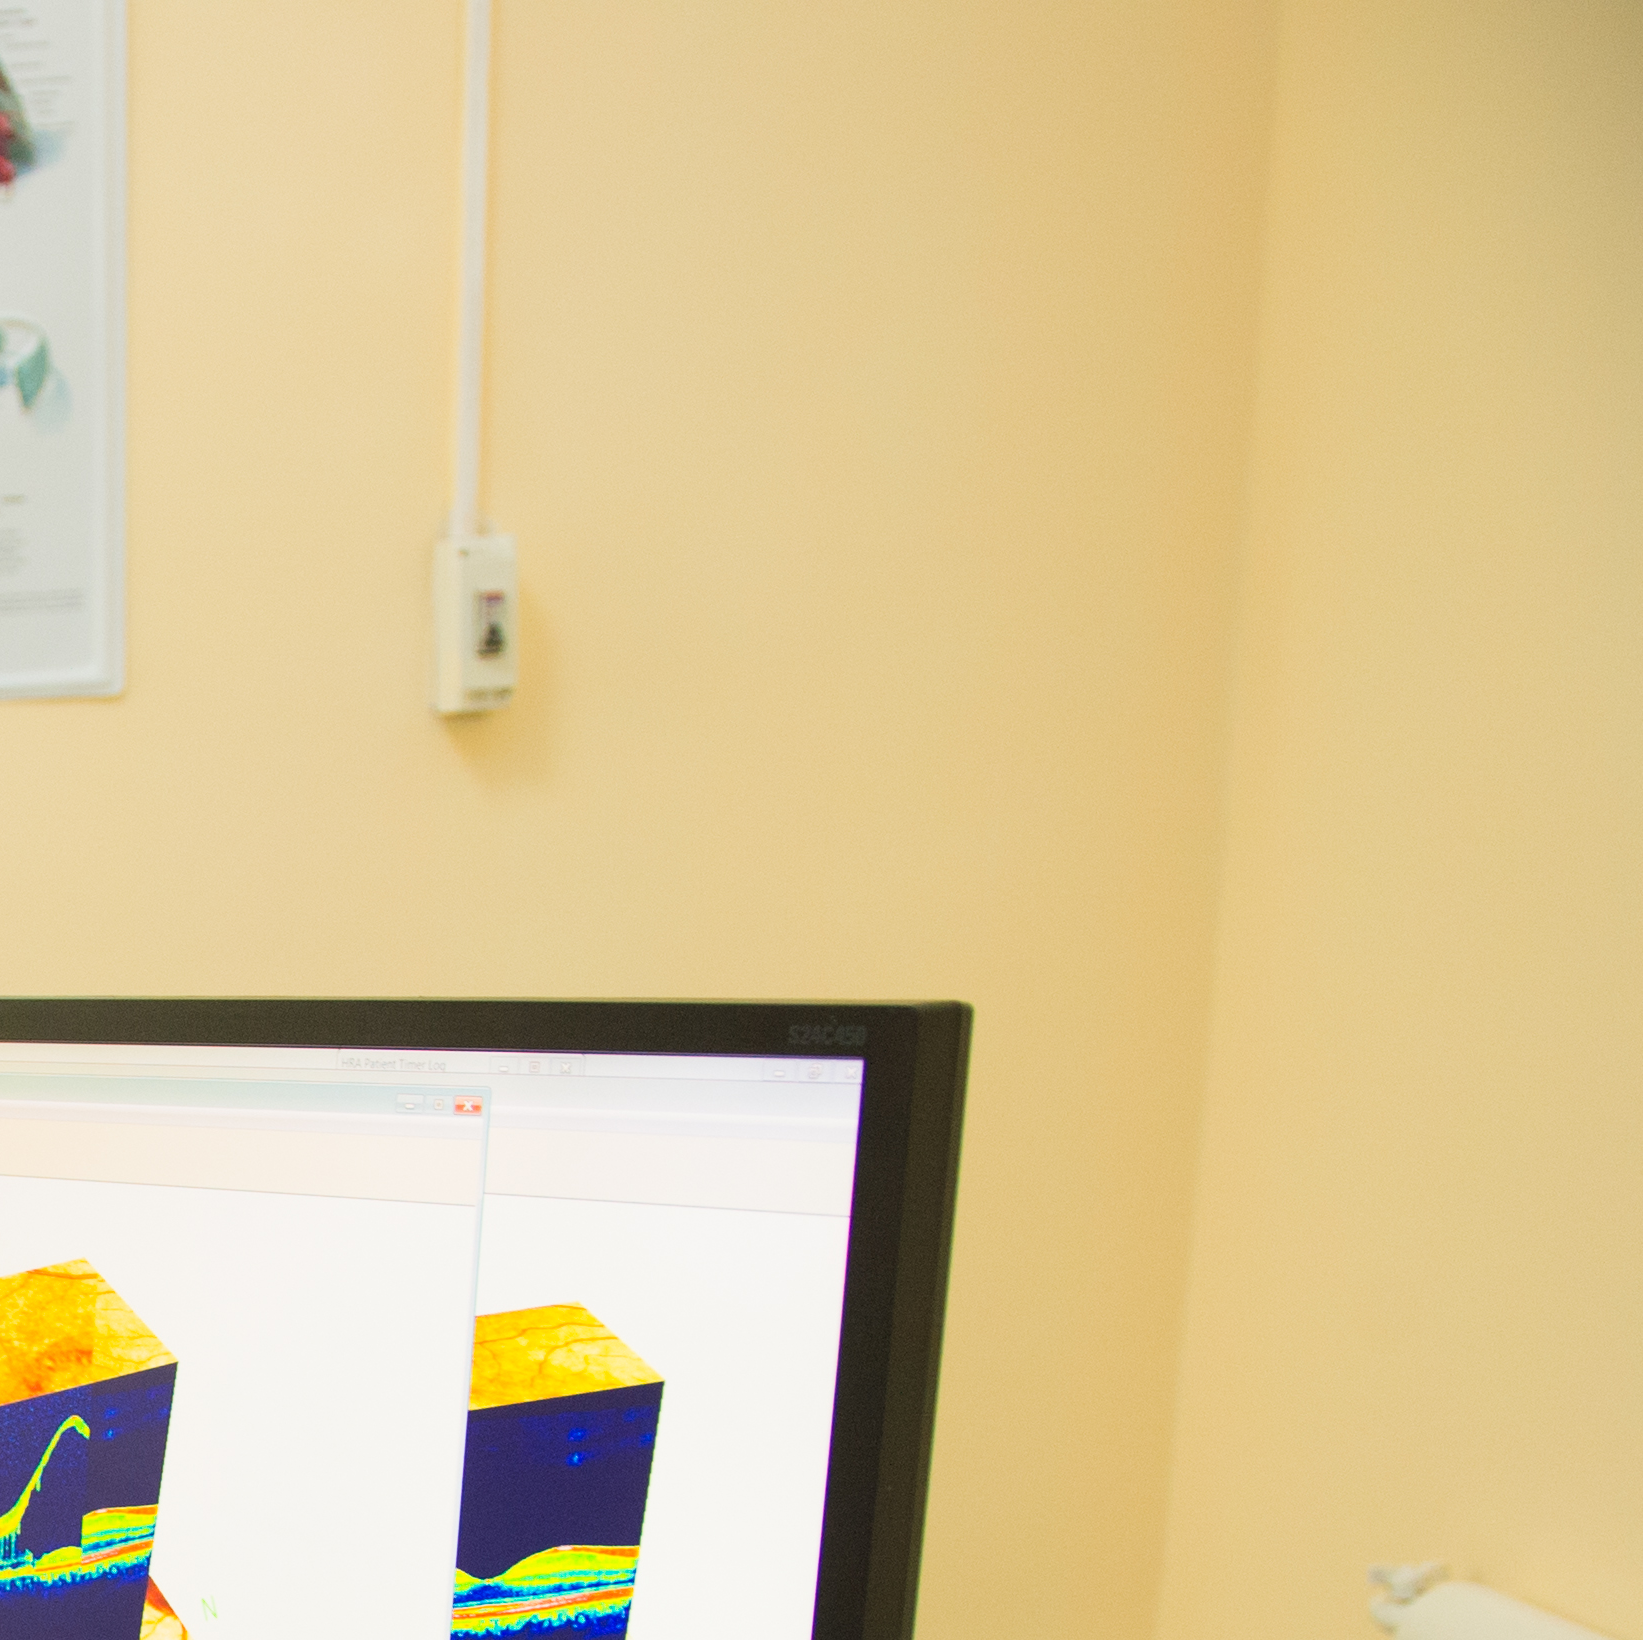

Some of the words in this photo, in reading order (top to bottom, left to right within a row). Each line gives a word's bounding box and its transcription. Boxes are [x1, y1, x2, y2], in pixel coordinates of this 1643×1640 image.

[341, 1057, 362, 1068] HRA
[365, 1058, 397, 1069] Patient
[399, 1058, 426, 1070] Timer
[428, 1060, 446, 1072] Log
